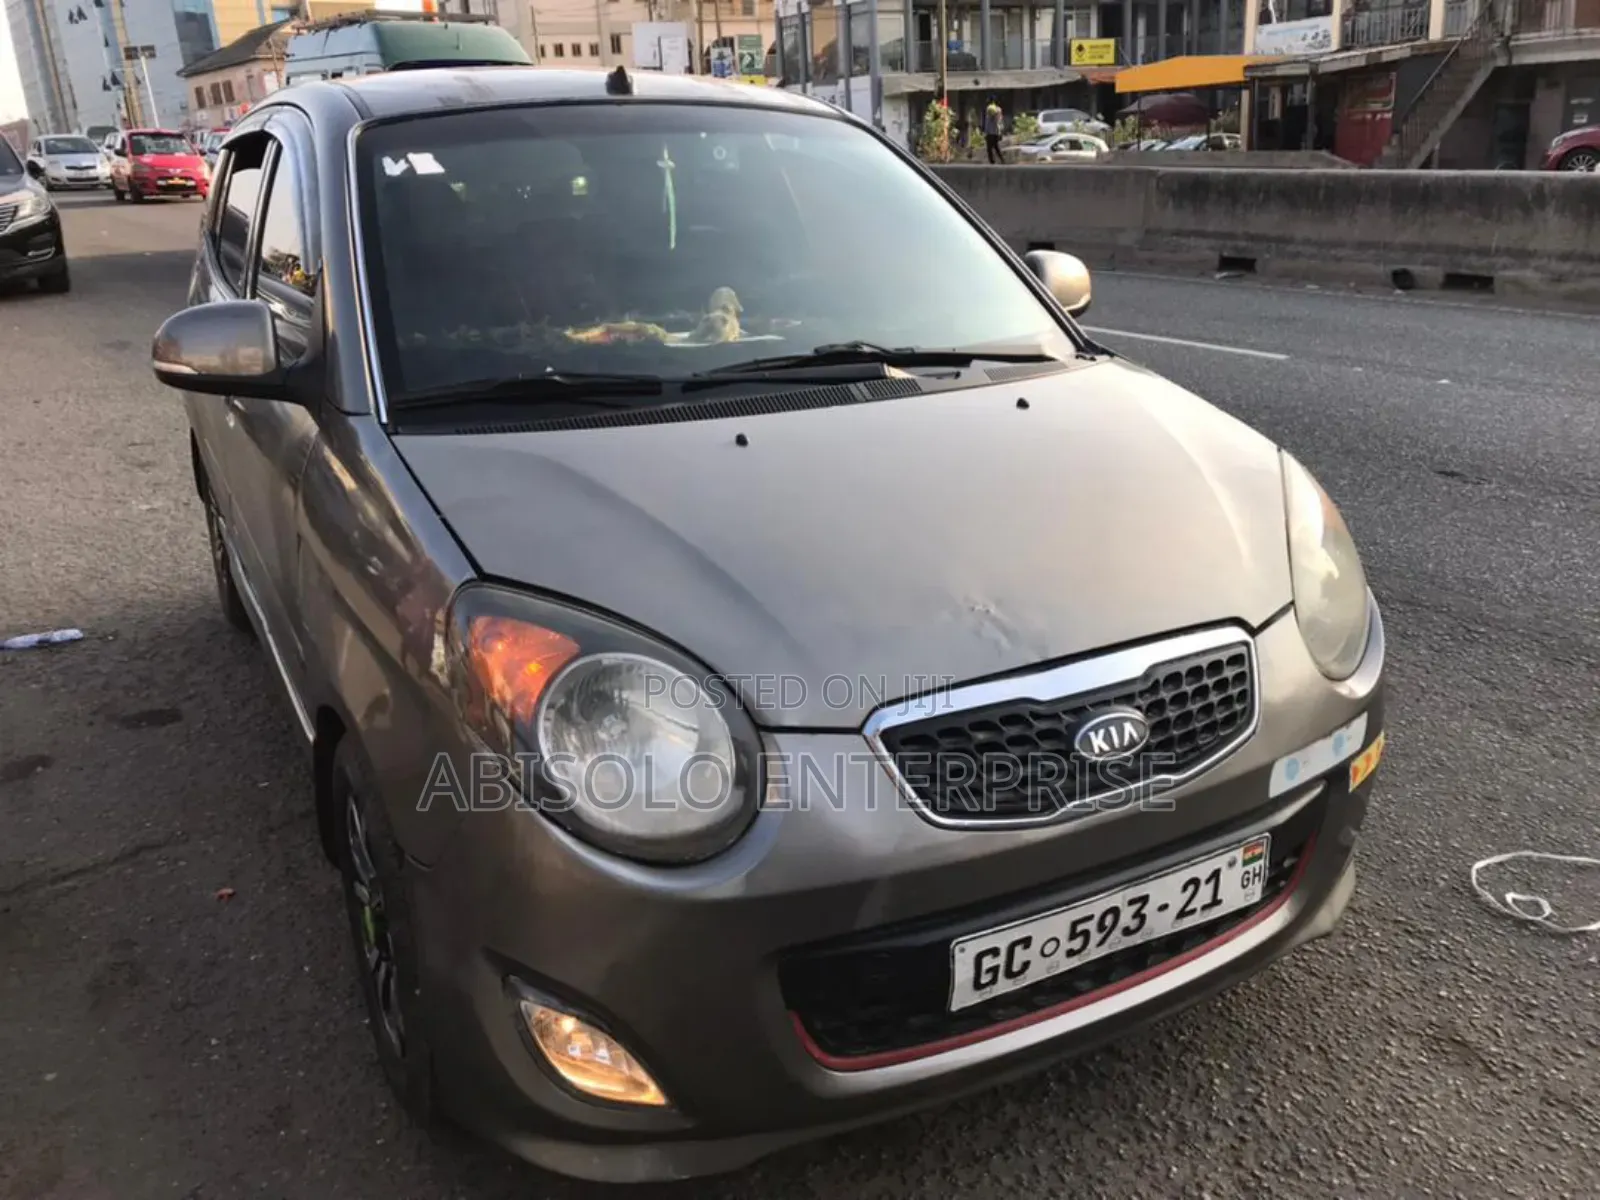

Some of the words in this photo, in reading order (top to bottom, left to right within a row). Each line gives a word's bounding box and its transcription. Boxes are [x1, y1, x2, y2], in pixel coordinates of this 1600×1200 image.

[1088, 721, 1139, 754] KIA
[1240, 864, 1262, 891] GH
[972, 935, 1032, 991] GC
